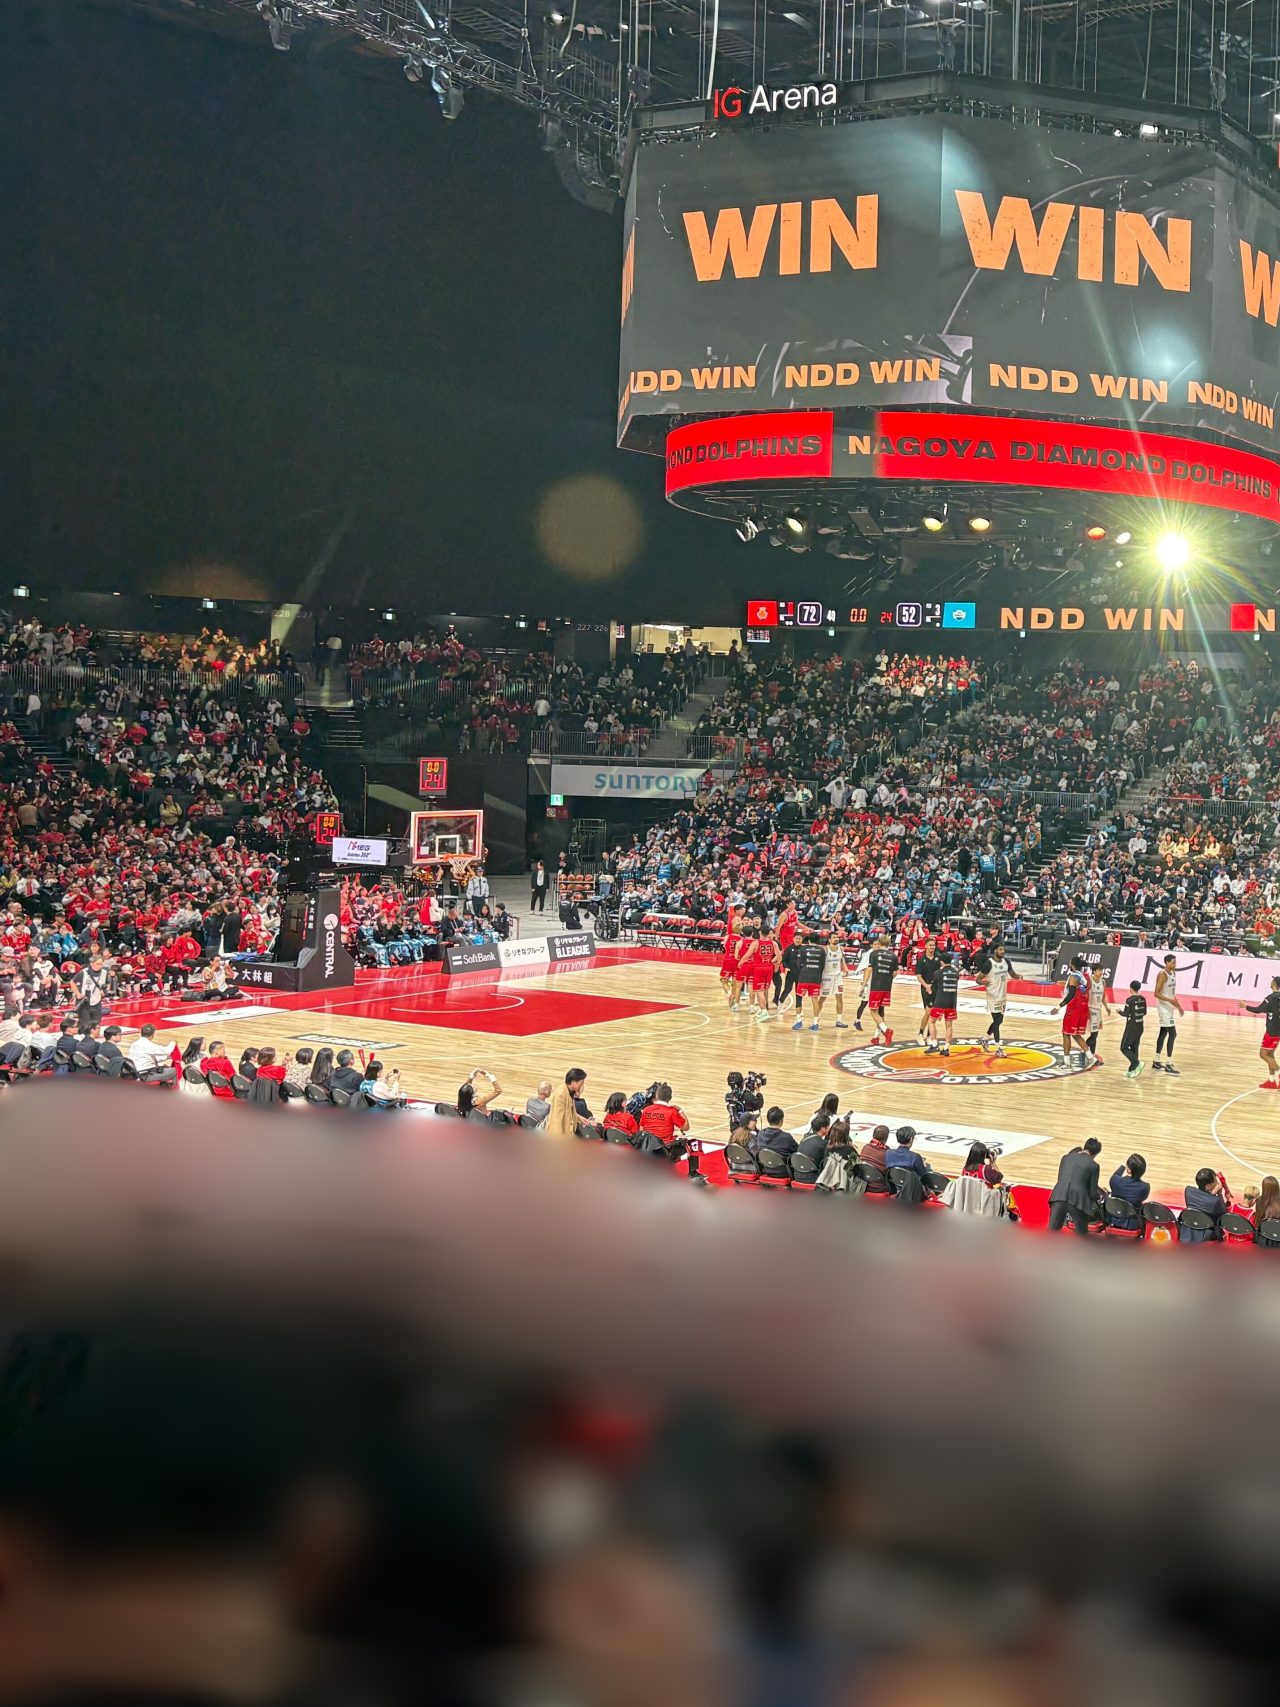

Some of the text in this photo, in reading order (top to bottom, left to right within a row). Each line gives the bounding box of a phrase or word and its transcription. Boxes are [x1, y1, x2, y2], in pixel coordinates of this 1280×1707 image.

[713, 81, 837, 118] IG Arena
[682, 193, 879, 282] WIN
[955, 189, 1192, 292] WIN
[630, 366, 756, 393] DD WIN
[785, 357, 941, 388] NDD WIN
[989, 363, 1169, 403] NDD WIN
[1187, 381, 1275, 430] NDD WIN
[695, 434, 823, 463] DOLPHINS
[848, 434, 996, 460] NAGOYA
[1009, 440, 1167, 475] DIAMOND
[1171, 459, 1272, 499] DOLPHINS
[803, 605, 817, 622] 72
[850, 608, 867, 622] 0.0
[880, 611, 893, 623] 24
[902, 606, 916, 623] 52
[1000, 607, 1185, 631] NDD WIN
[424, 773, 441, 788] 24
[324, 931, 335, 979] CENTRAL
[463, 951, 497, 965] SoftBank
[511, 946, 545, 957] りそなグループ
[555, 944, 591, 959] B.LEAGUE
[242, 968, 273, 983] 大林組
